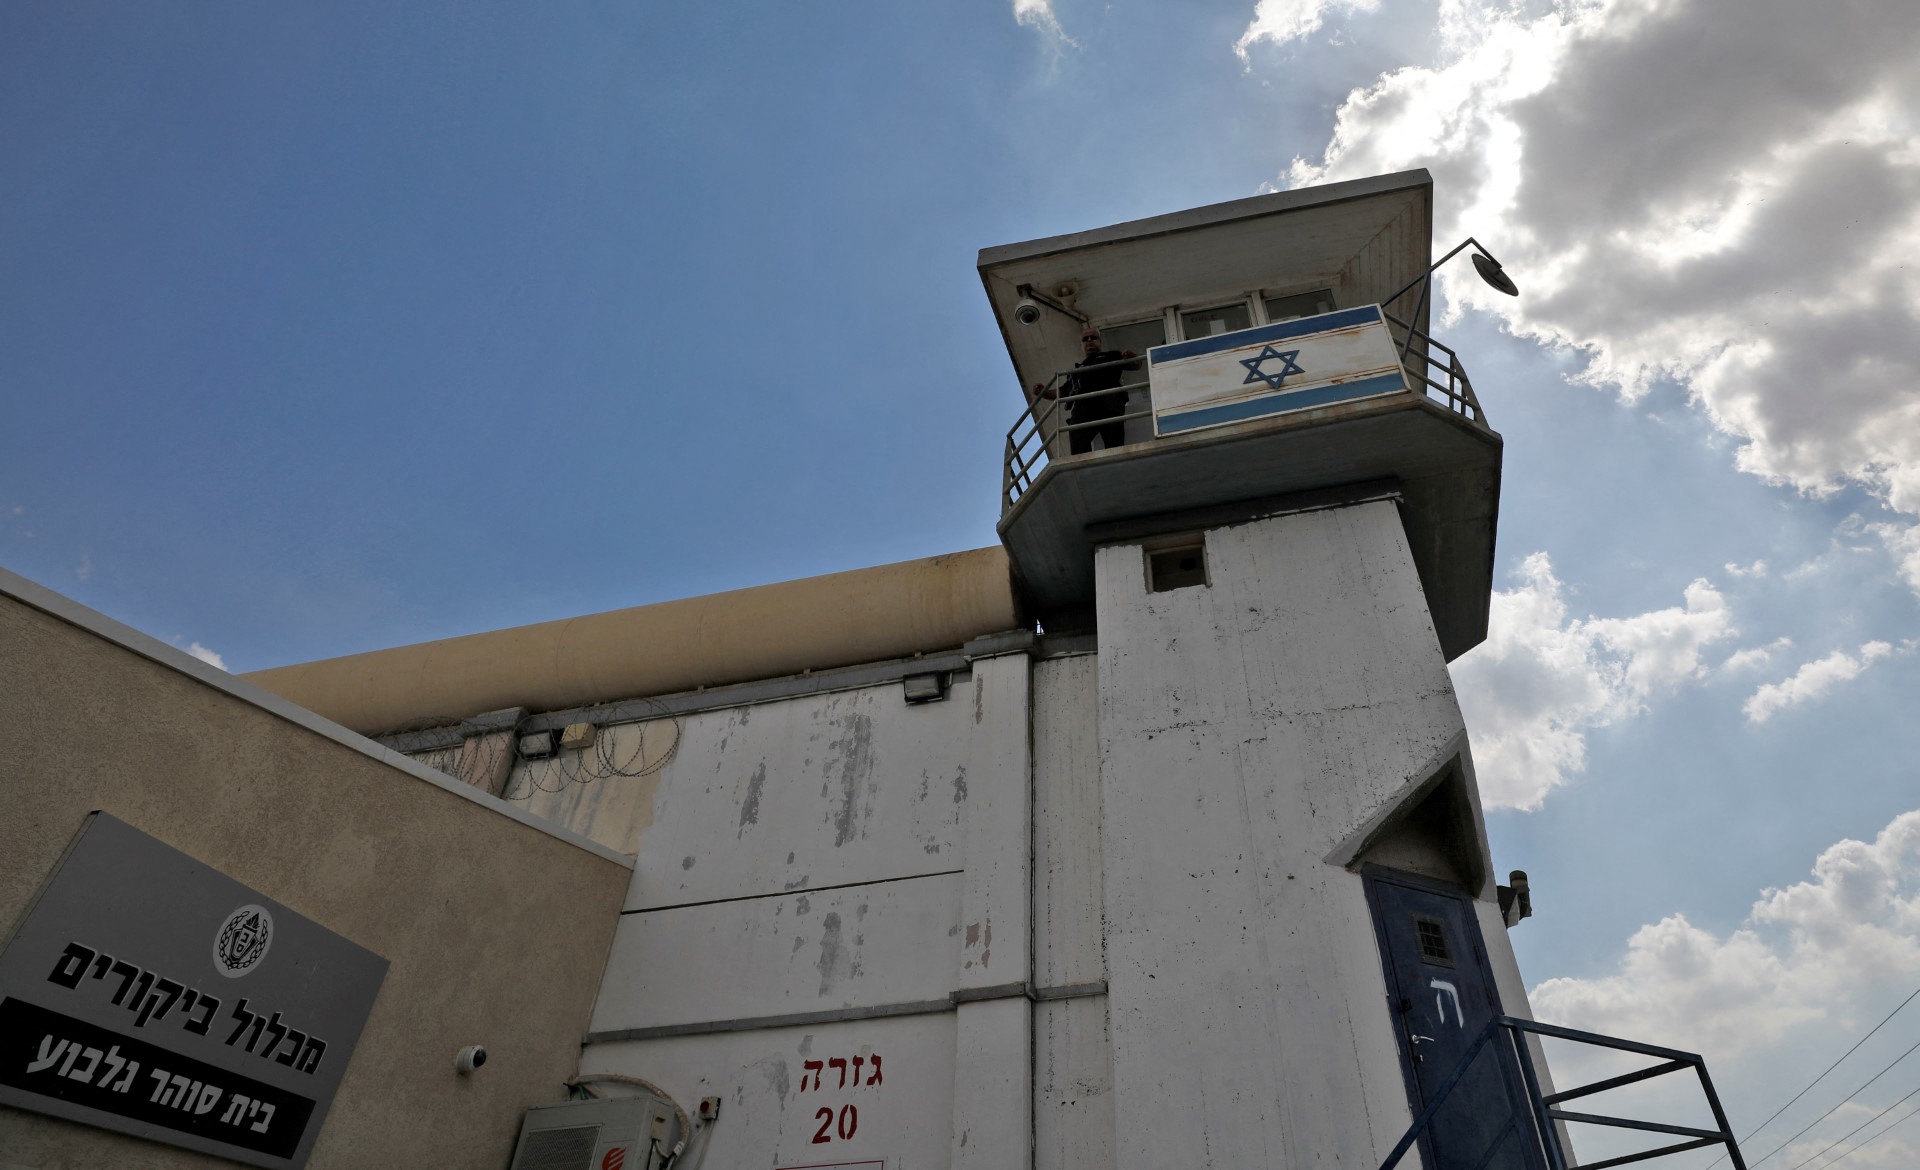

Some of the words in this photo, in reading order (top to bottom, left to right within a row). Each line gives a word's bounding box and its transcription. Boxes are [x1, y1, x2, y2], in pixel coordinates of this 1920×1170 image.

[47, 942, 221, 1036] ביקורים
[225, 998, 327, 1075] מכלול
[26, 1034, 140, 1093] גלבוע
[801, 1053, 883, 1093] גזרה
[150, 1068, 223, 1115] סוהר
[220, 1093, 276, 1134] בית
[812, 1104, 857, 1144] 20
